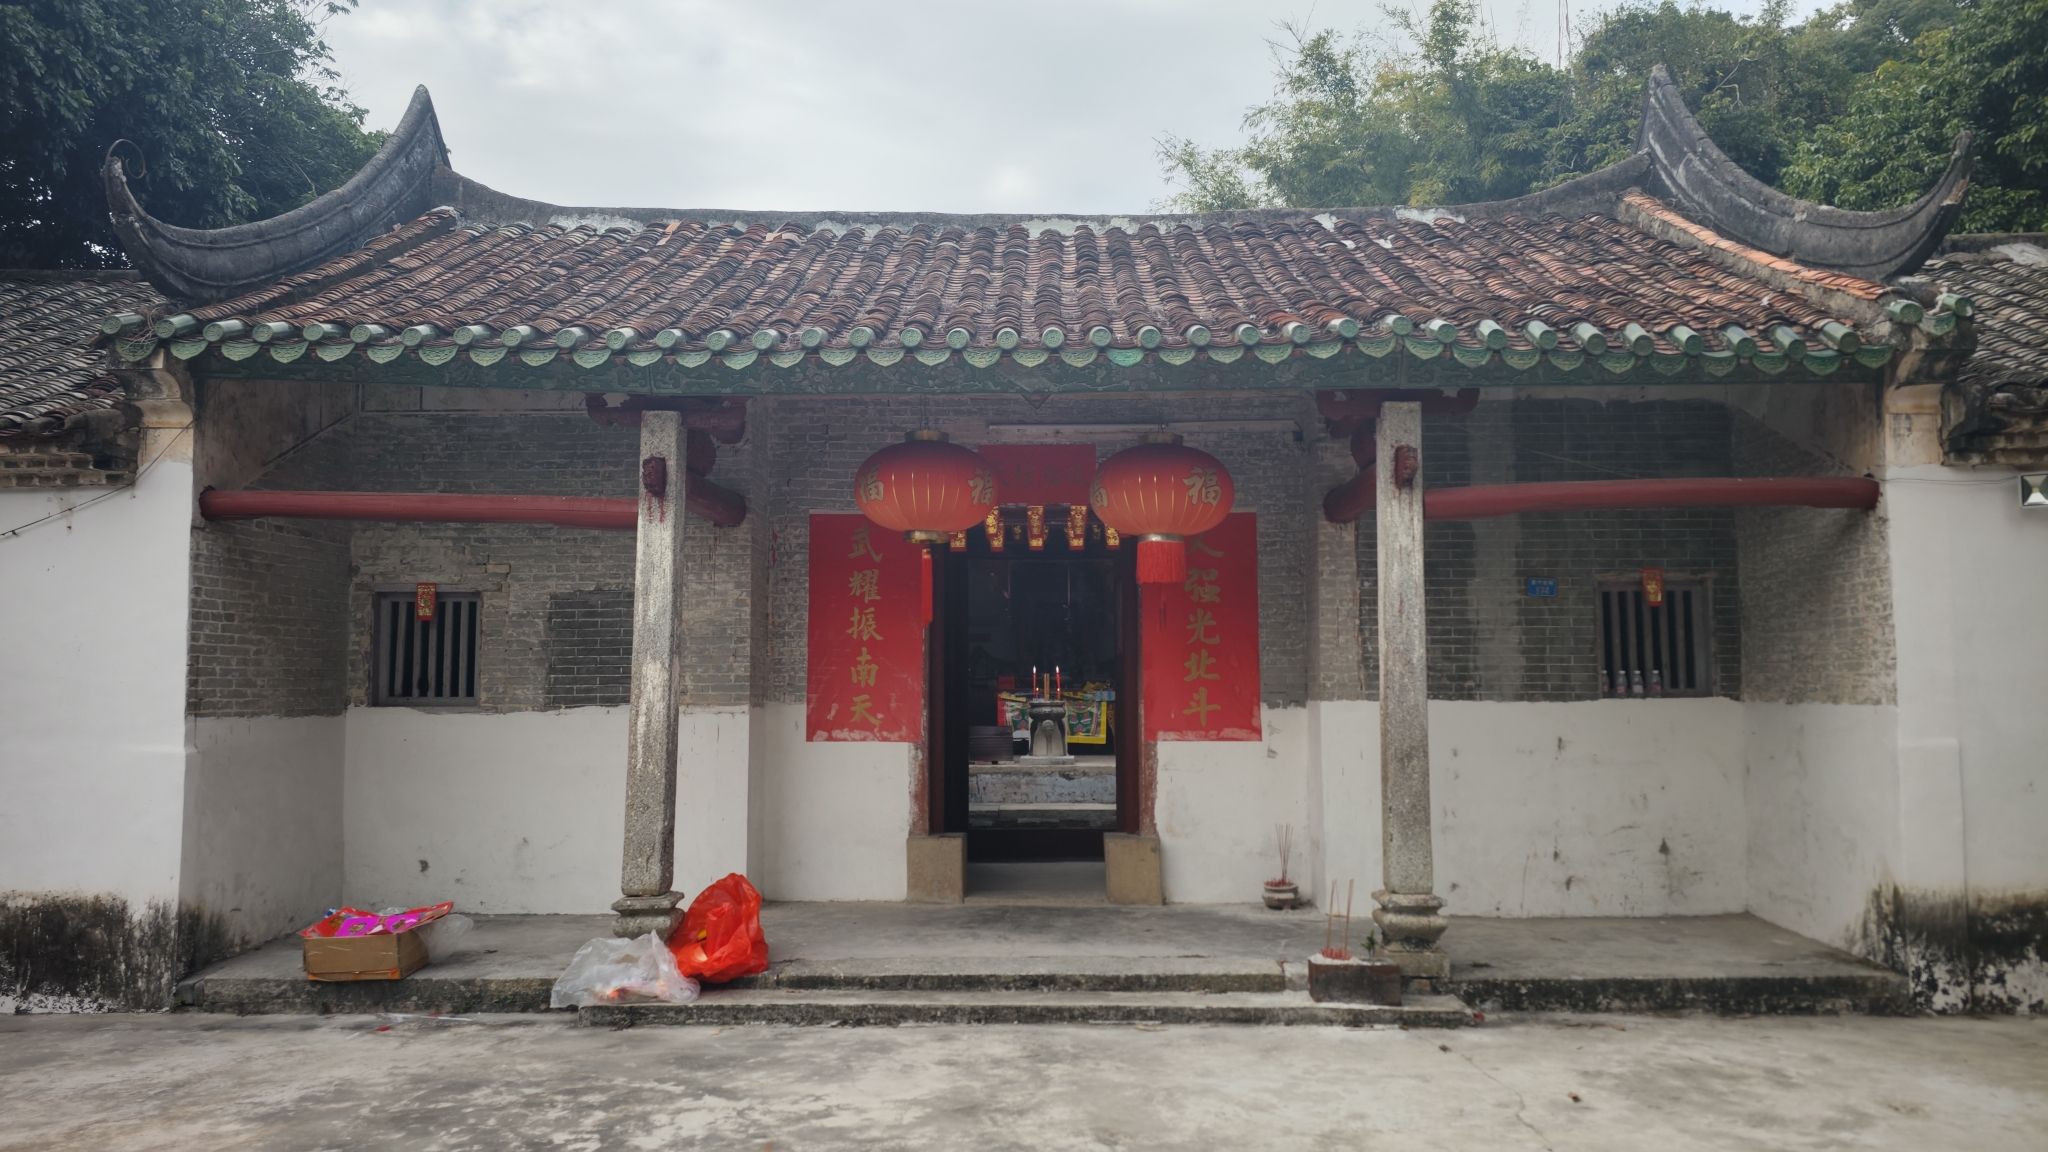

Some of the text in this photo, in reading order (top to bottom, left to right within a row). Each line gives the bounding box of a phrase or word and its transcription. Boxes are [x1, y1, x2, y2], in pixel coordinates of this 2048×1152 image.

[1183, 466, 1222, 506] 福
[847, 522, 884, 727] 武耀振南天
